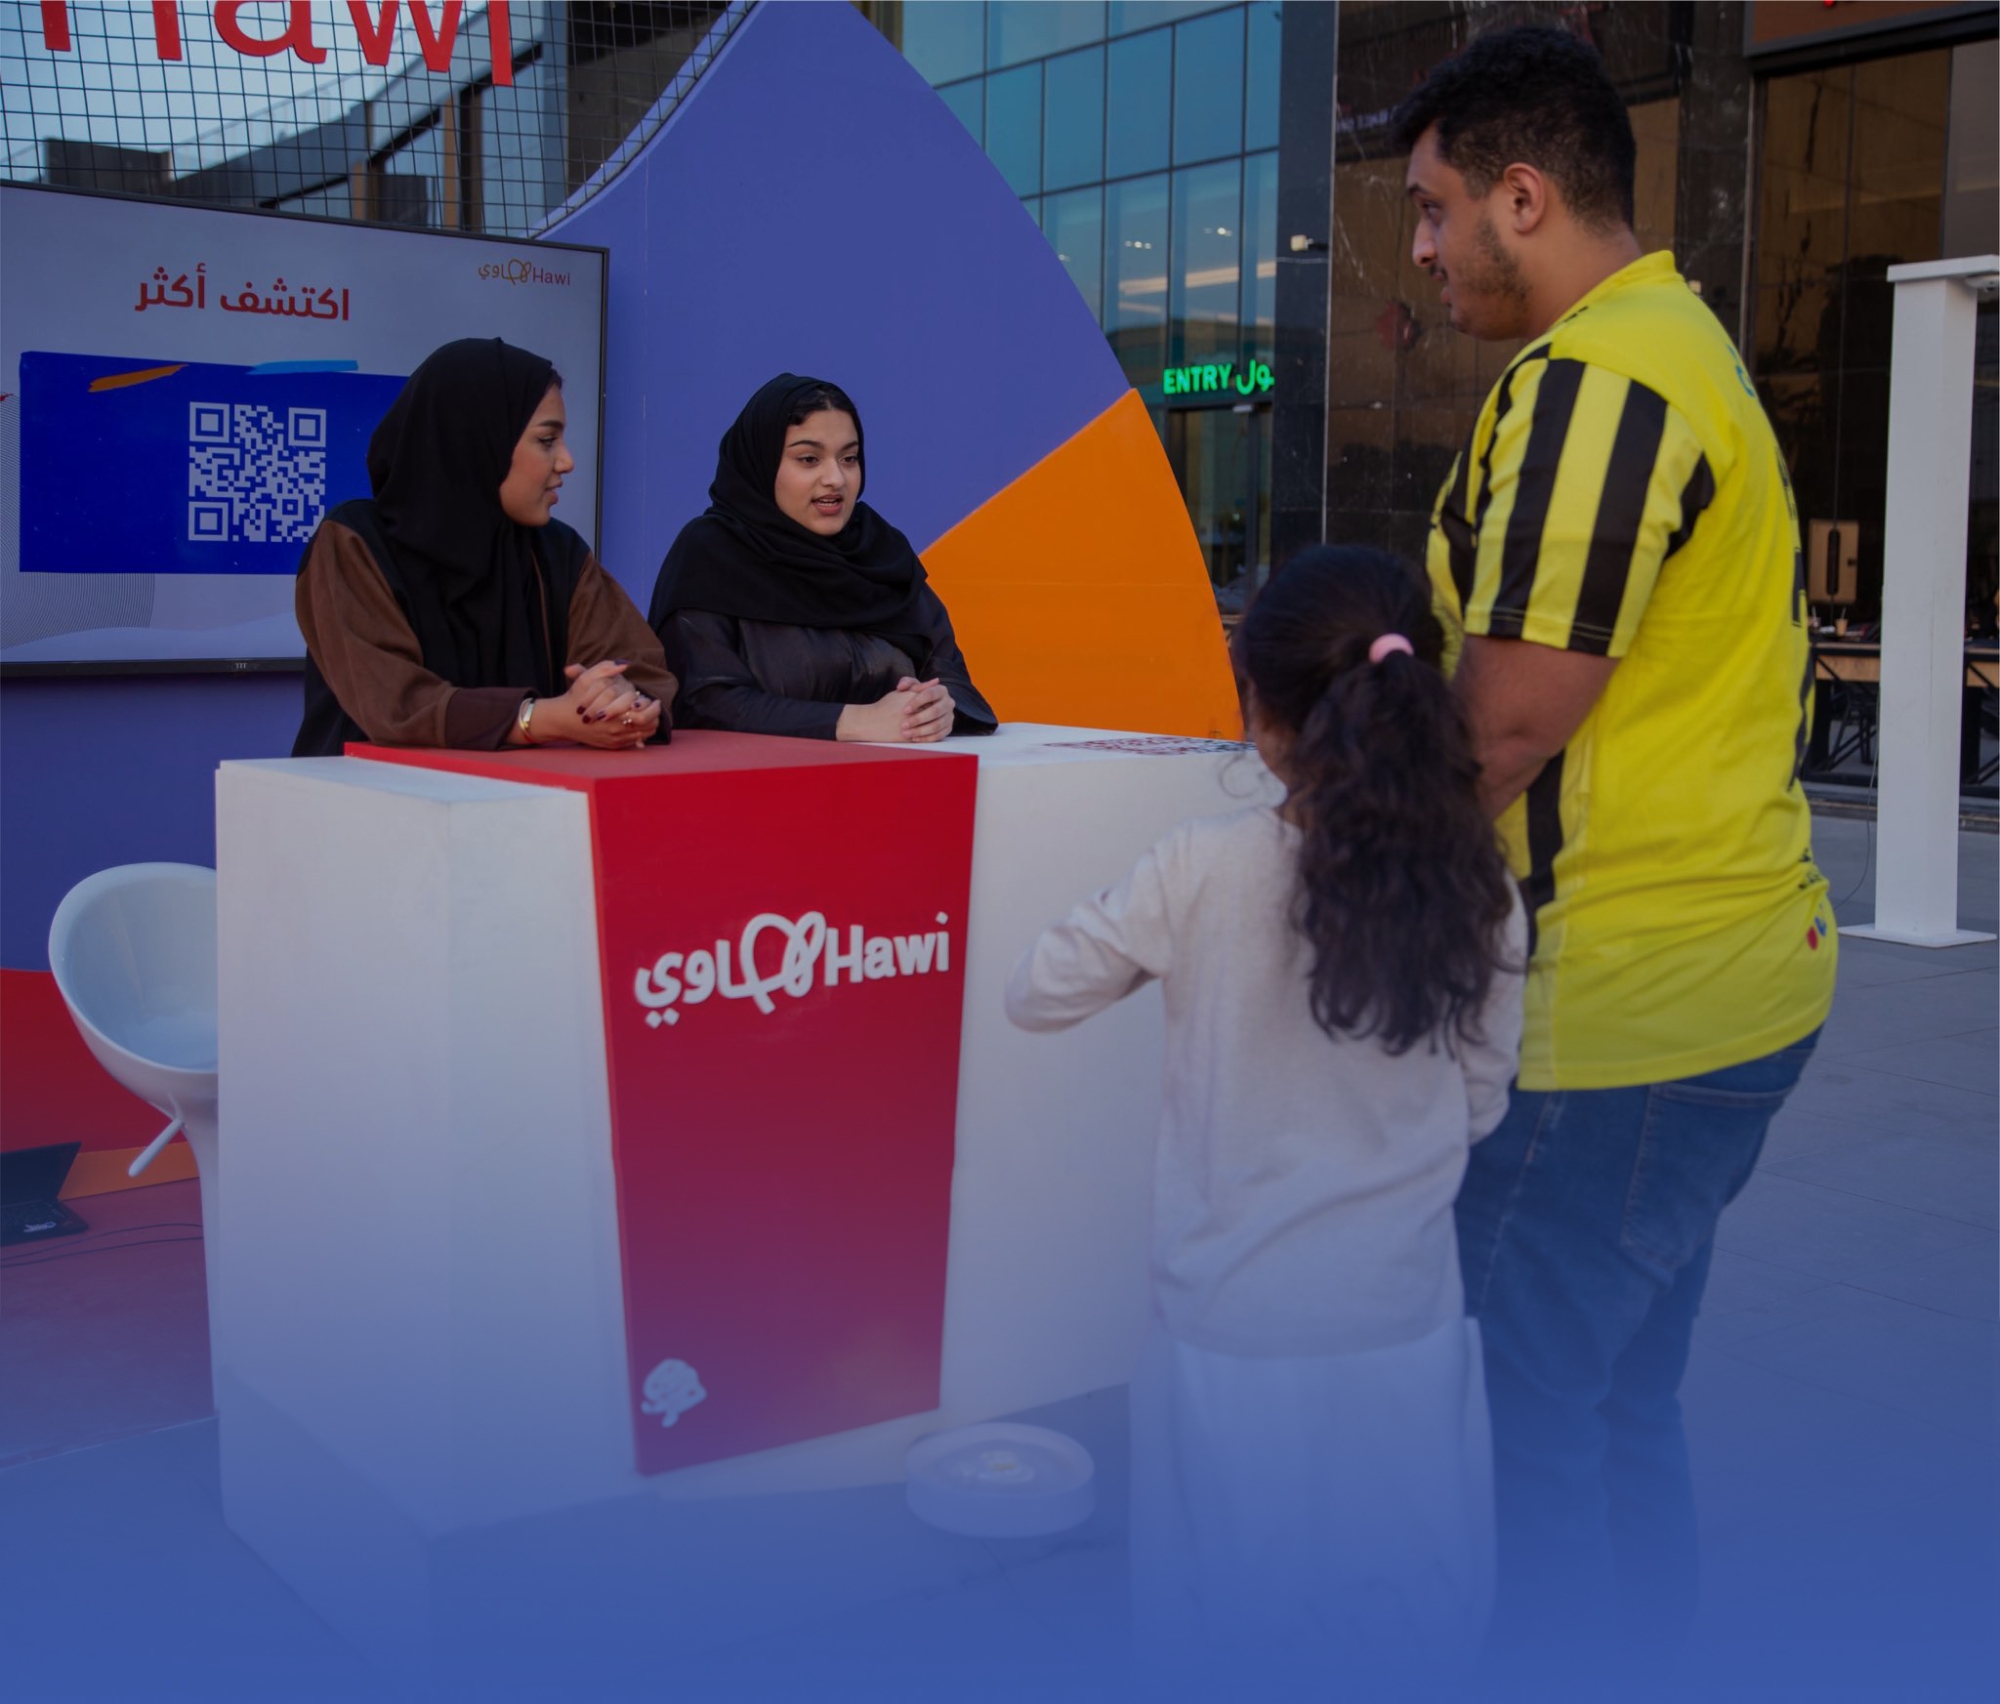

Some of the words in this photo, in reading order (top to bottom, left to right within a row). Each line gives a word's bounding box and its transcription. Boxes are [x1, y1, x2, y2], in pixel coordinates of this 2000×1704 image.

[135, 262, 206, 311] أكثر
[532, 266, 571, 286] Hawi
[220, 277, 349, 320] اكتشف
[1163, 363, 1232, 394] ENTRY
[824, 911, 949, 986] Hawi
